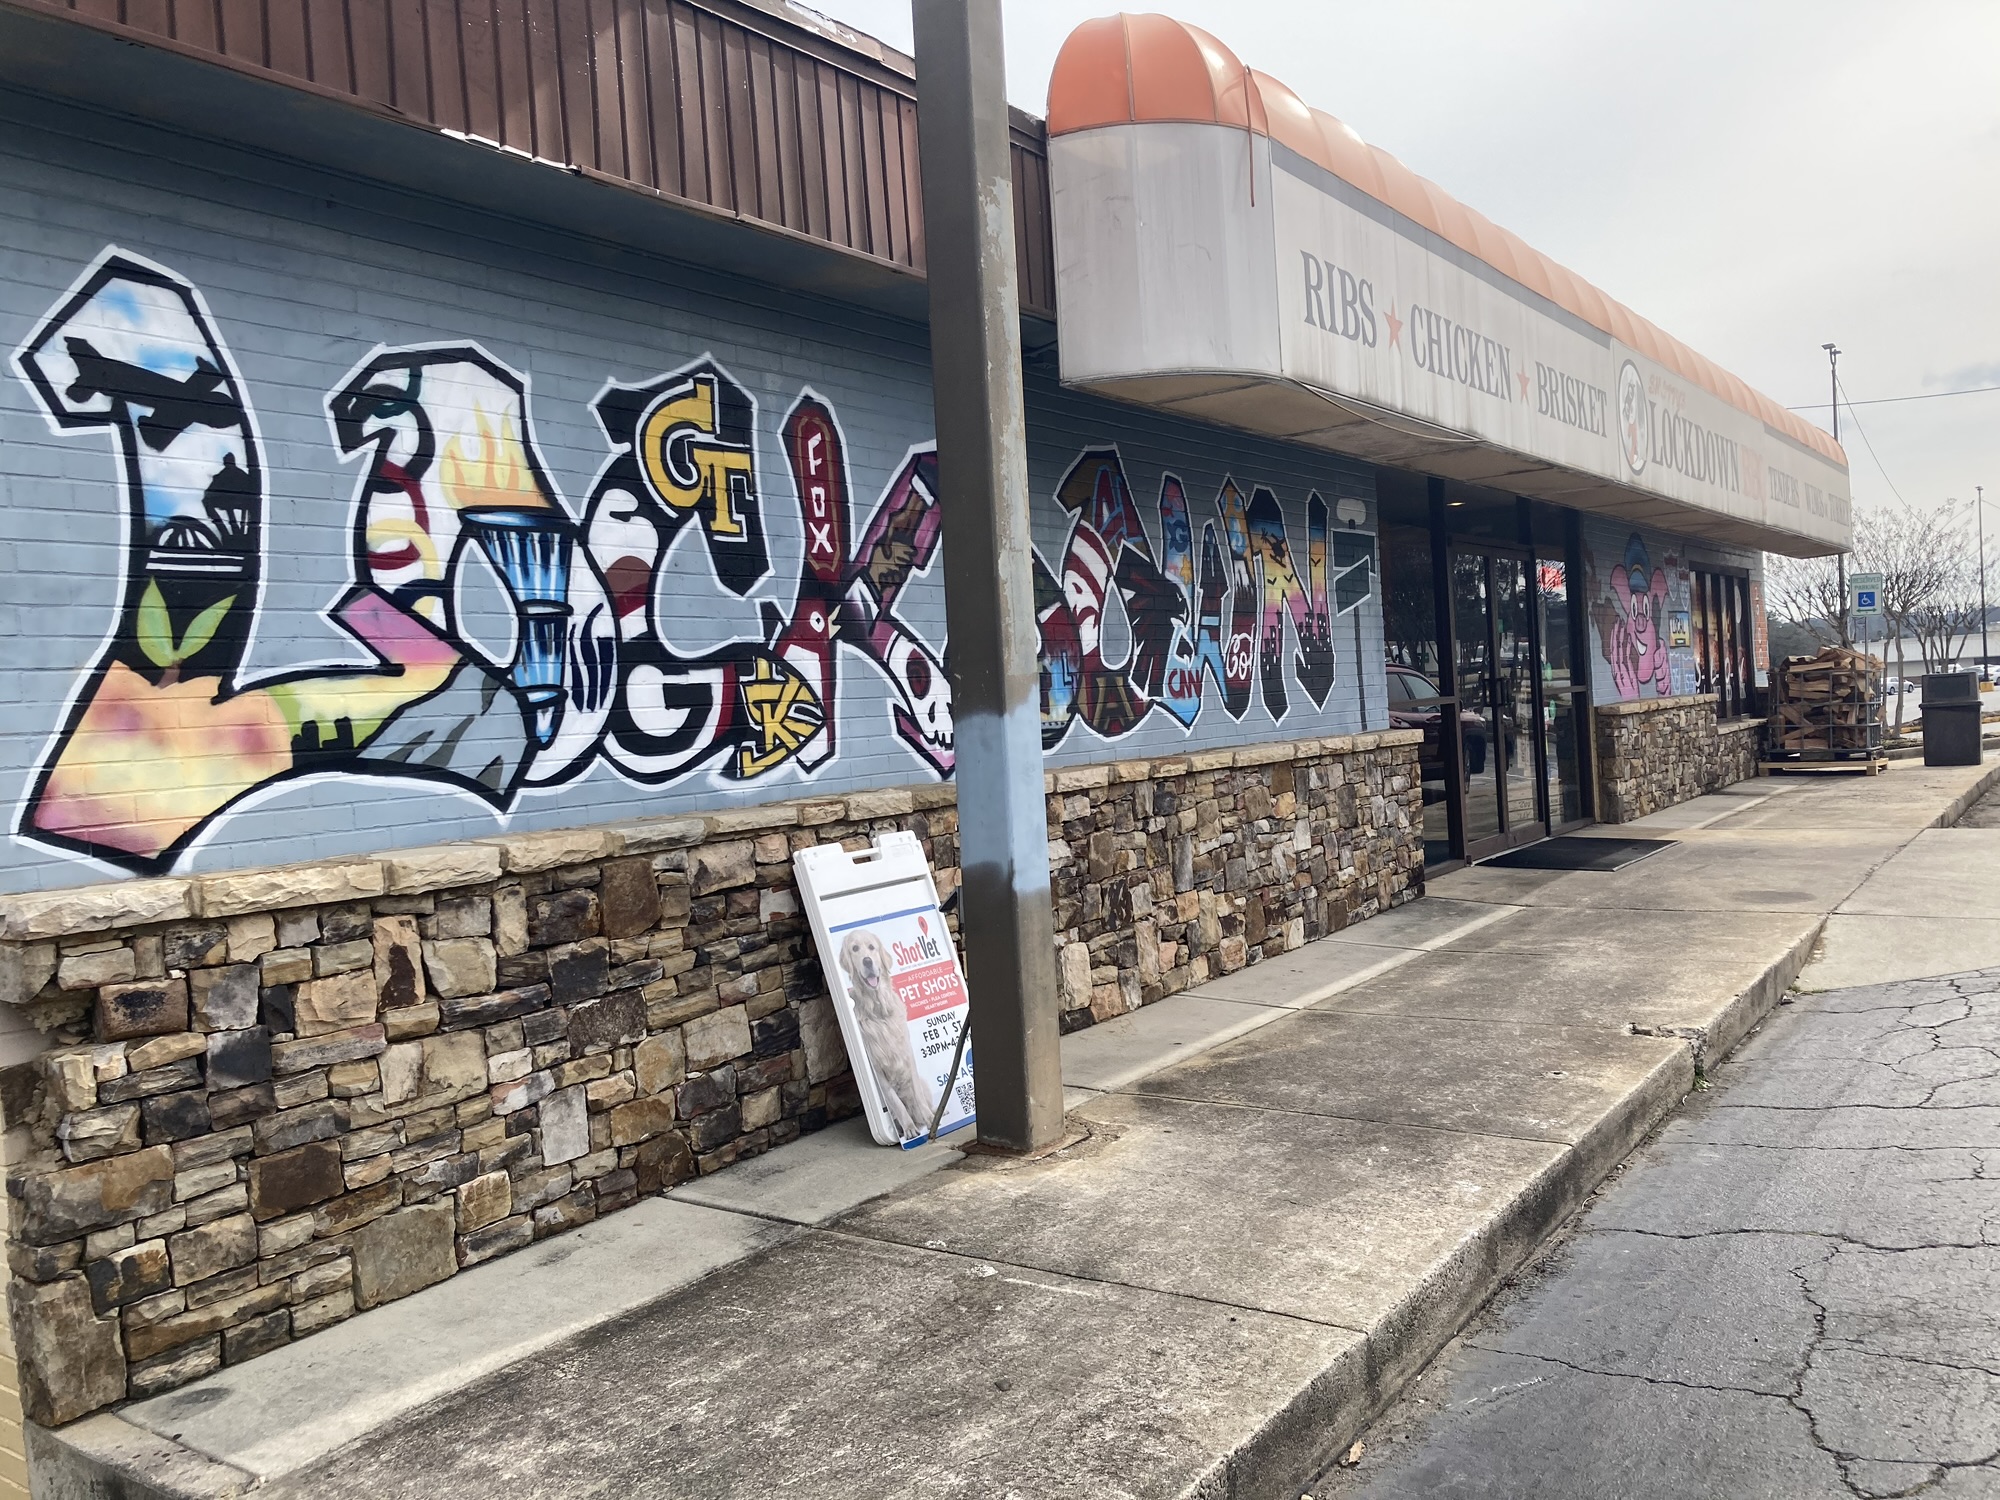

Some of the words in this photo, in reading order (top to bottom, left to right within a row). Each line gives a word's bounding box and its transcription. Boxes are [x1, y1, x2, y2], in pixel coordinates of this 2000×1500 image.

[1301, 250, 1377, 348] RIBS
[1411, 304, 1513, 403] CHICKEN
[1535, 361, 1608, 439] BRISKET
[641, 378, 753, 536] GT
[1649, 400, 1739, 493] LOCKDOWN
[807, 432, 834, 555] FOX
[892, 935, 941, 966] ShotVet
[899, 982, 922, 1003] PET
[921, 973, 960, 997] SHOTS
[908, 966, 944, 982] AFFORDABLE
[922, 1028, 940, 1042] FEB
[942, 1025, 949, 1036] 1
[951, 1020, 964, 1033] ST
[926, 1010, 957, 1028] SUNDAY
